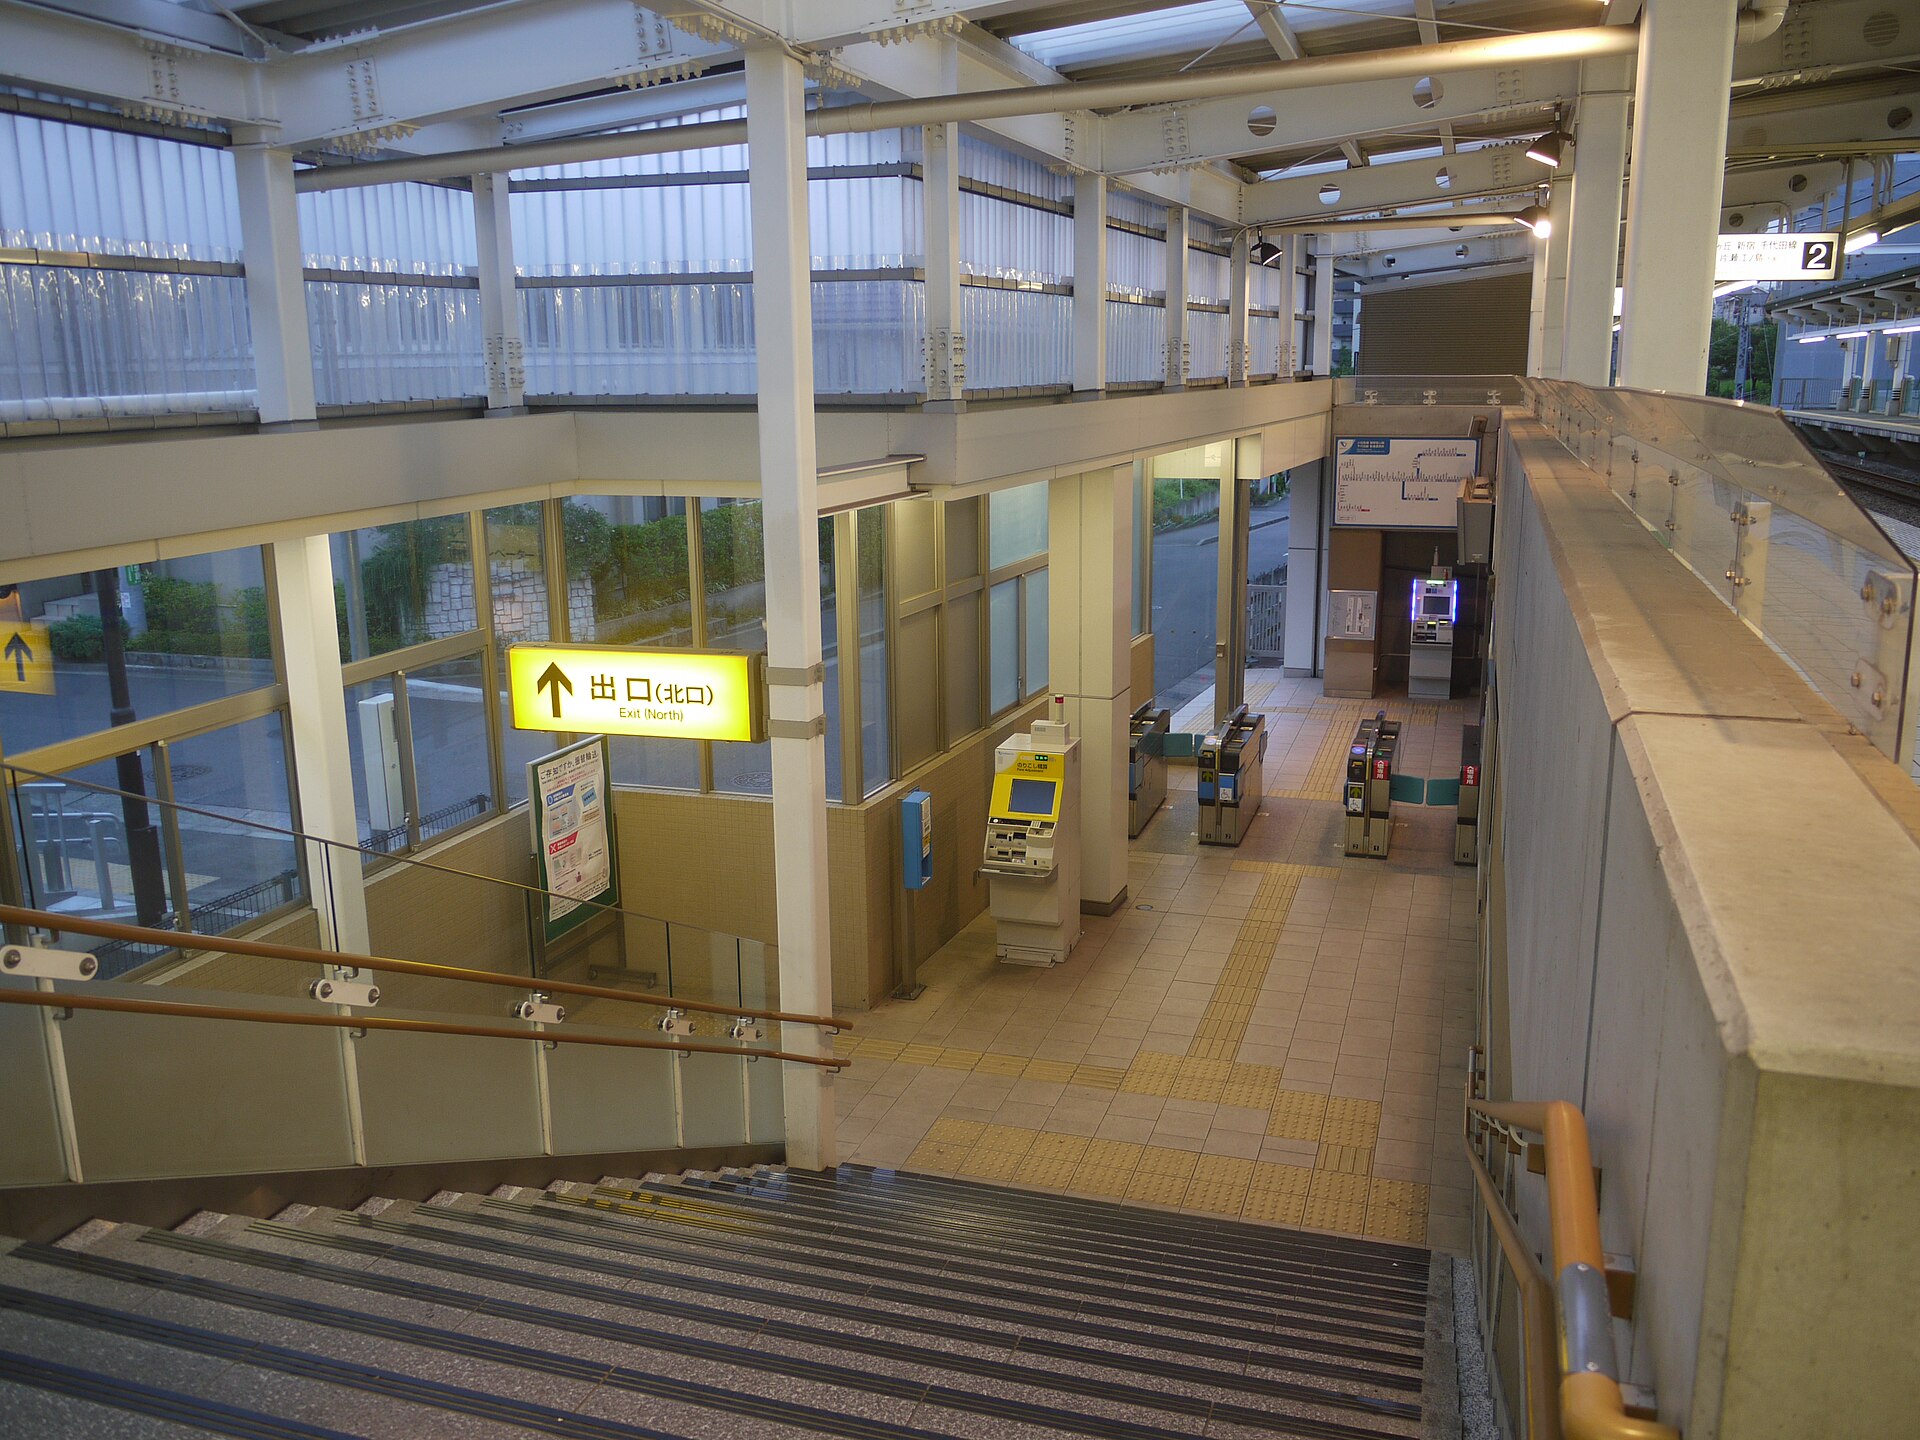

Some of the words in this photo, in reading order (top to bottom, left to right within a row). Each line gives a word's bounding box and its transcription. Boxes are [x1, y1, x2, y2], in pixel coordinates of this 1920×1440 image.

[1806, 243, 1828, 269] 2
[619, 707, 641, 719] Exit
[644, 708, 684, 722] (North)
